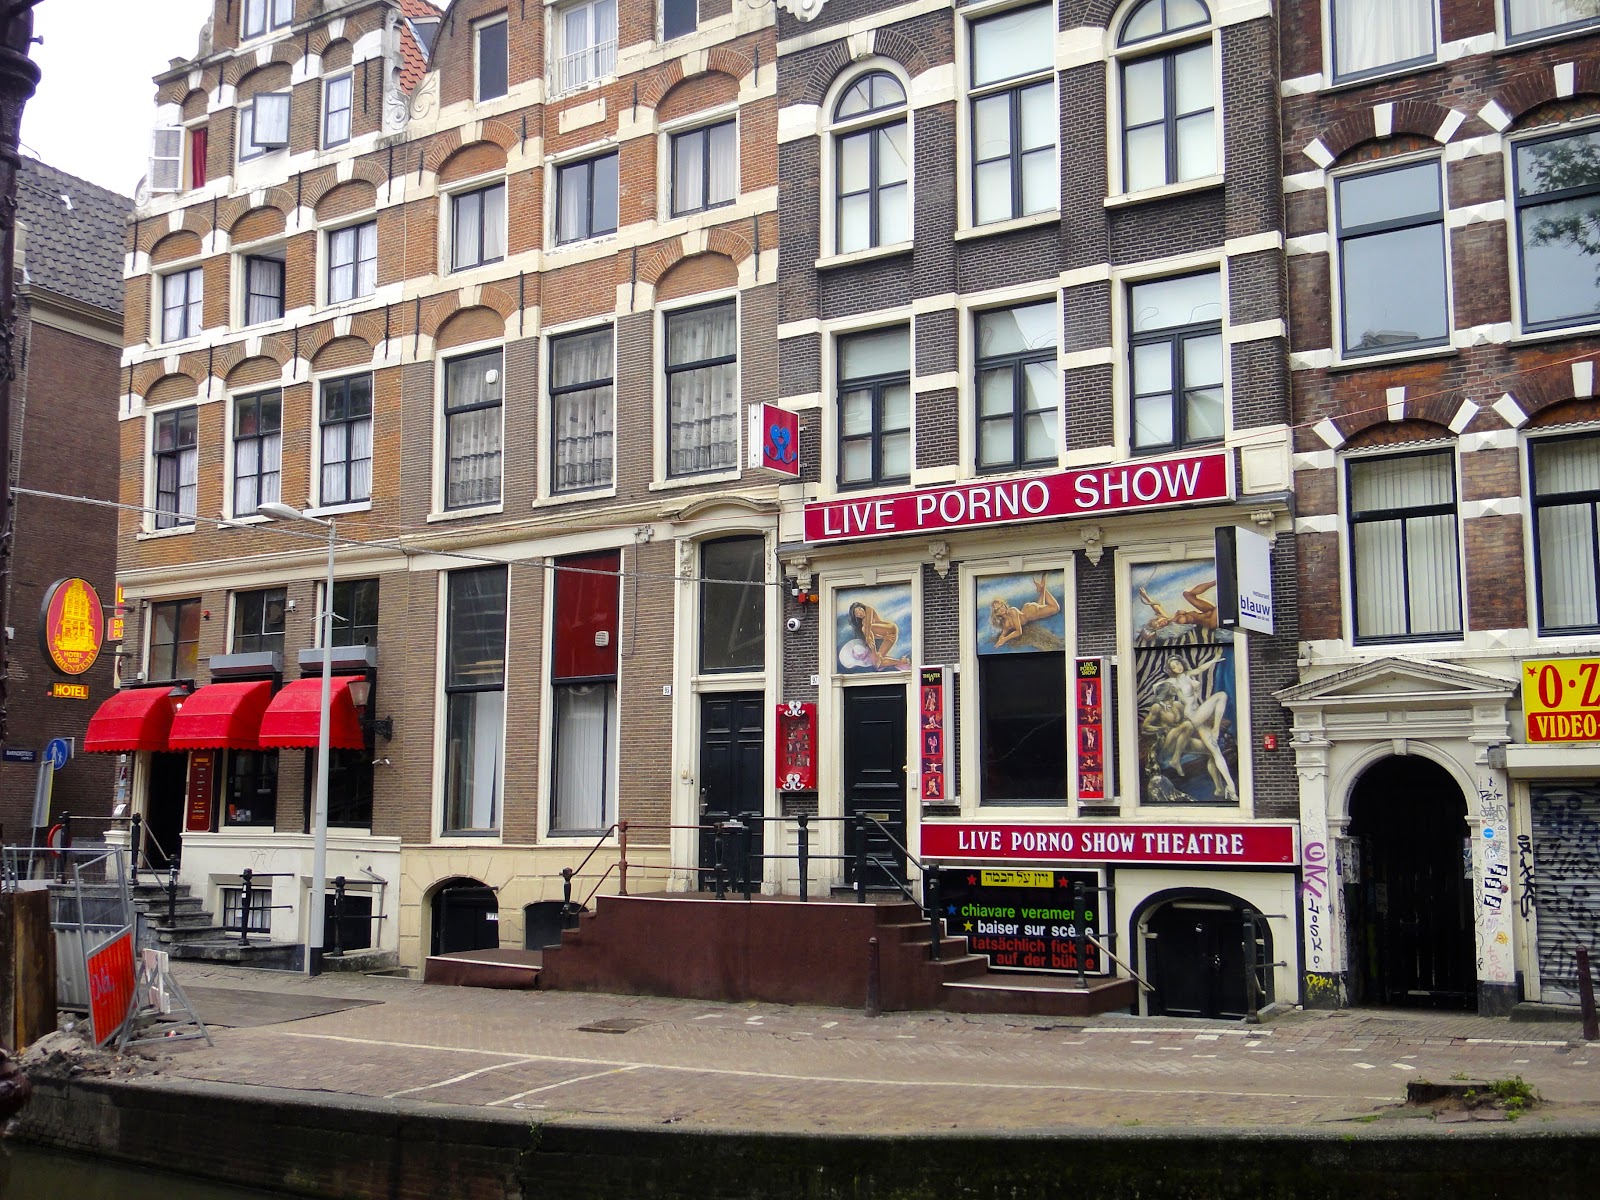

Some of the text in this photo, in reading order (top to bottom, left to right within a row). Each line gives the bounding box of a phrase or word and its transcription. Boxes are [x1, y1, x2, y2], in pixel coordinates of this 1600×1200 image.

[822, 462, 1202, 536] LIVE PORNO SHOW
[1240, 594, 1271, 616] blauw
[114, 619, 124, 628] BA
[113, 629, 124, 638] PU
[53, 650, 97, 672] TORENZICHT
[63, 651, 83, 659] HOTEL
[55, 686, 87, 697] HOTEL
[958, 830, 1244, 855] LIVE PORNO SHOW THEATRE
[961, 903, 1094, 921] chiavare veramene
[977, 920, 1094, 937] baiser sur scèe
[972, 936, 1095, 955] tatsächlich fickn
[996, 952, 1095, 969] auf der bühe
